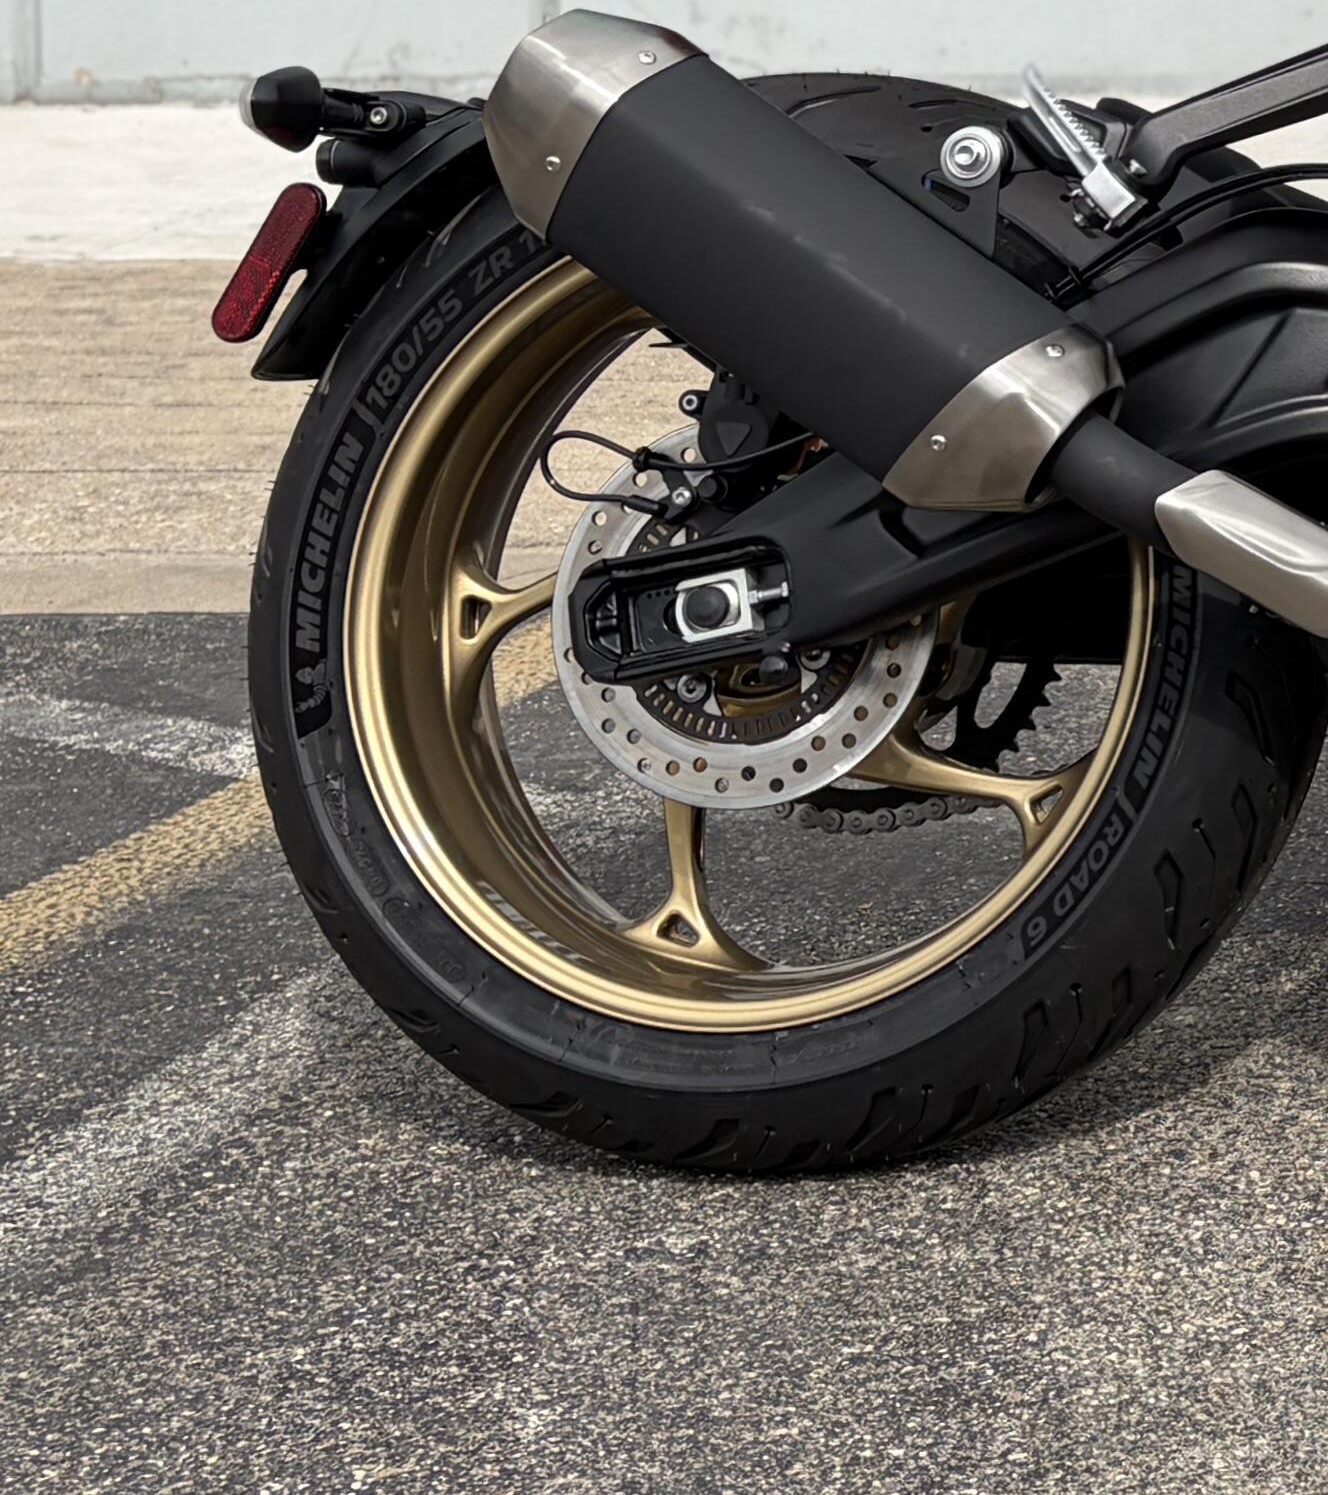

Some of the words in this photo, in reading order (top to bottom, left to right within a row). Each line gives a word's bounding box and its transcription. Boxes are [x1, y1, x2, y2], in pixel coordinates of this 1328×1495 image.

[366, 288, 463, 410] 180/55
[467, 246, 515, 296] ZR
[295, 432, 364, 653] MICHELIN
[1131, 564, 1194, 792] MICHELIN
[1025, 914, 1048, 948] 6
[1052, 814, 1126, 909] ROAD
